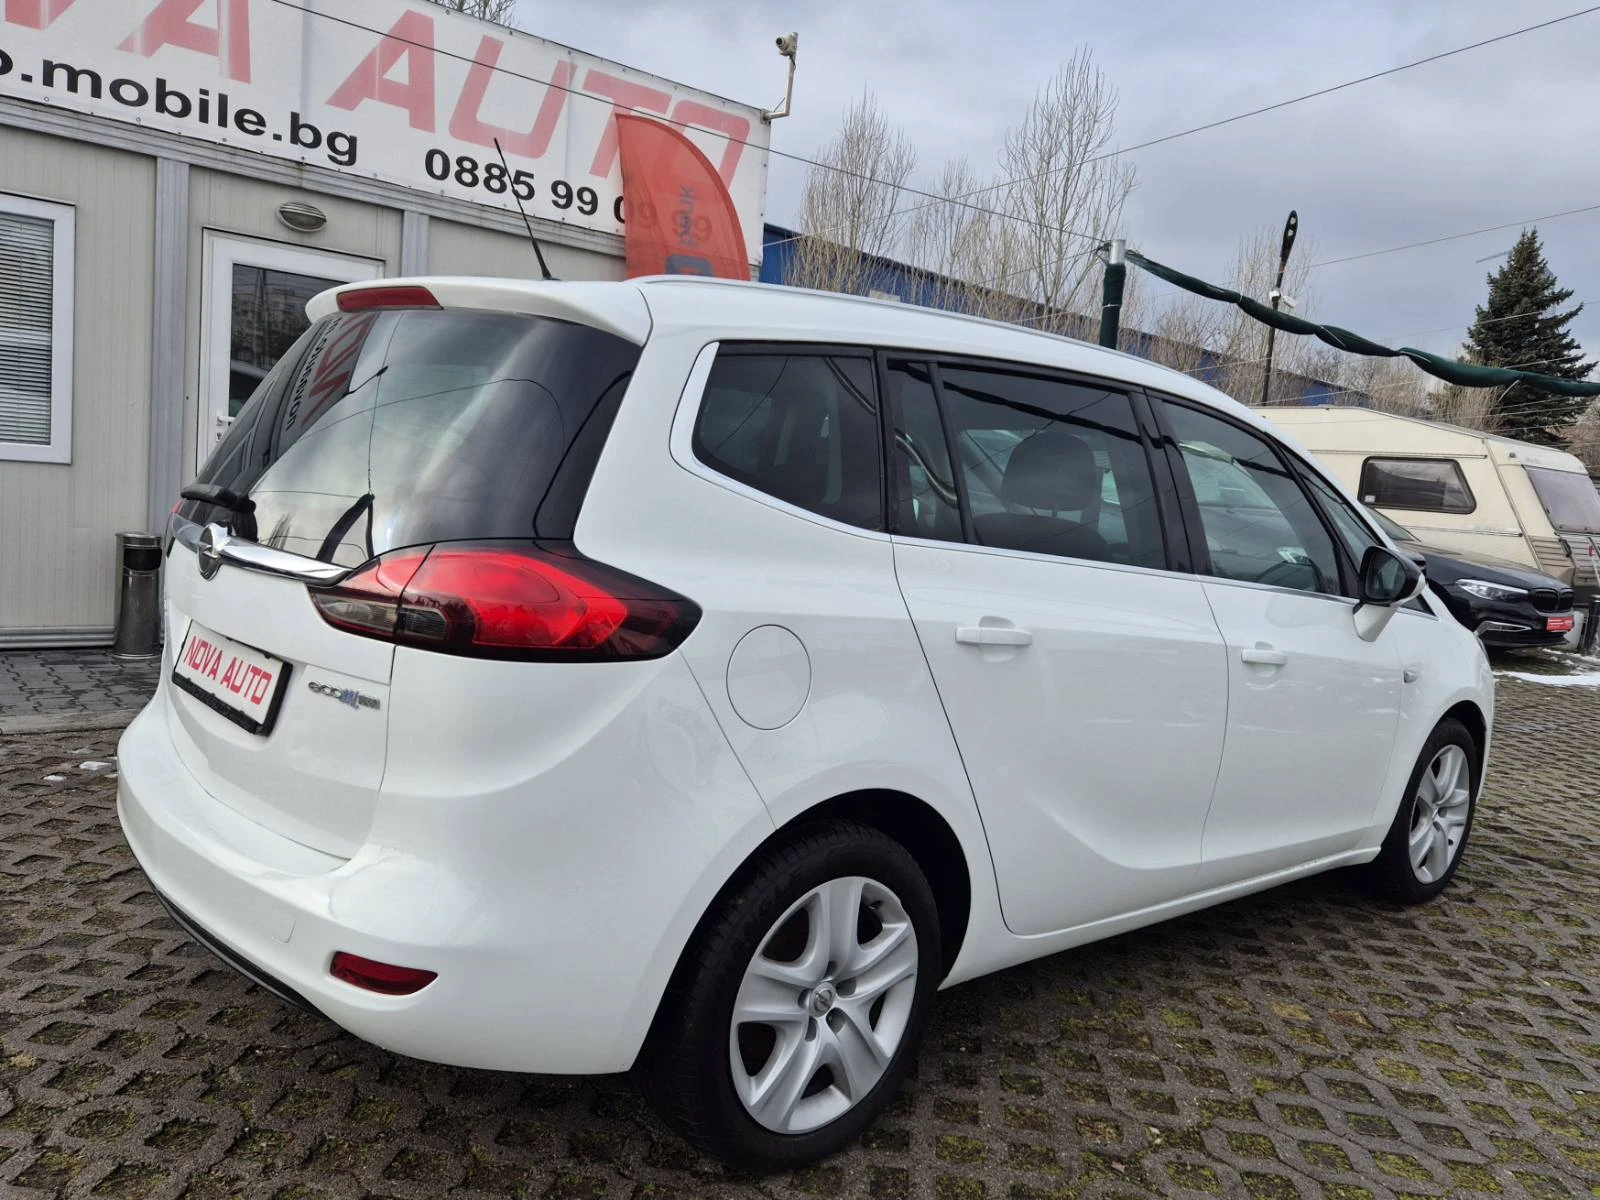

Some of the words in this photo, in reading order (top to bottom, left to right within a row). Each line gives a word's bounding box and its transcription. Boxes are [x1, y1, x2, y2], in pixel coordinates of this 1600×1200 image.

[3, 0, 251, 85] A
[425, 148, 536, 201] 0885
[551, 179, 599, 216] 99
[183, 635, 223, 680] NOVA
[220, 656, 273, 706] AUTO
